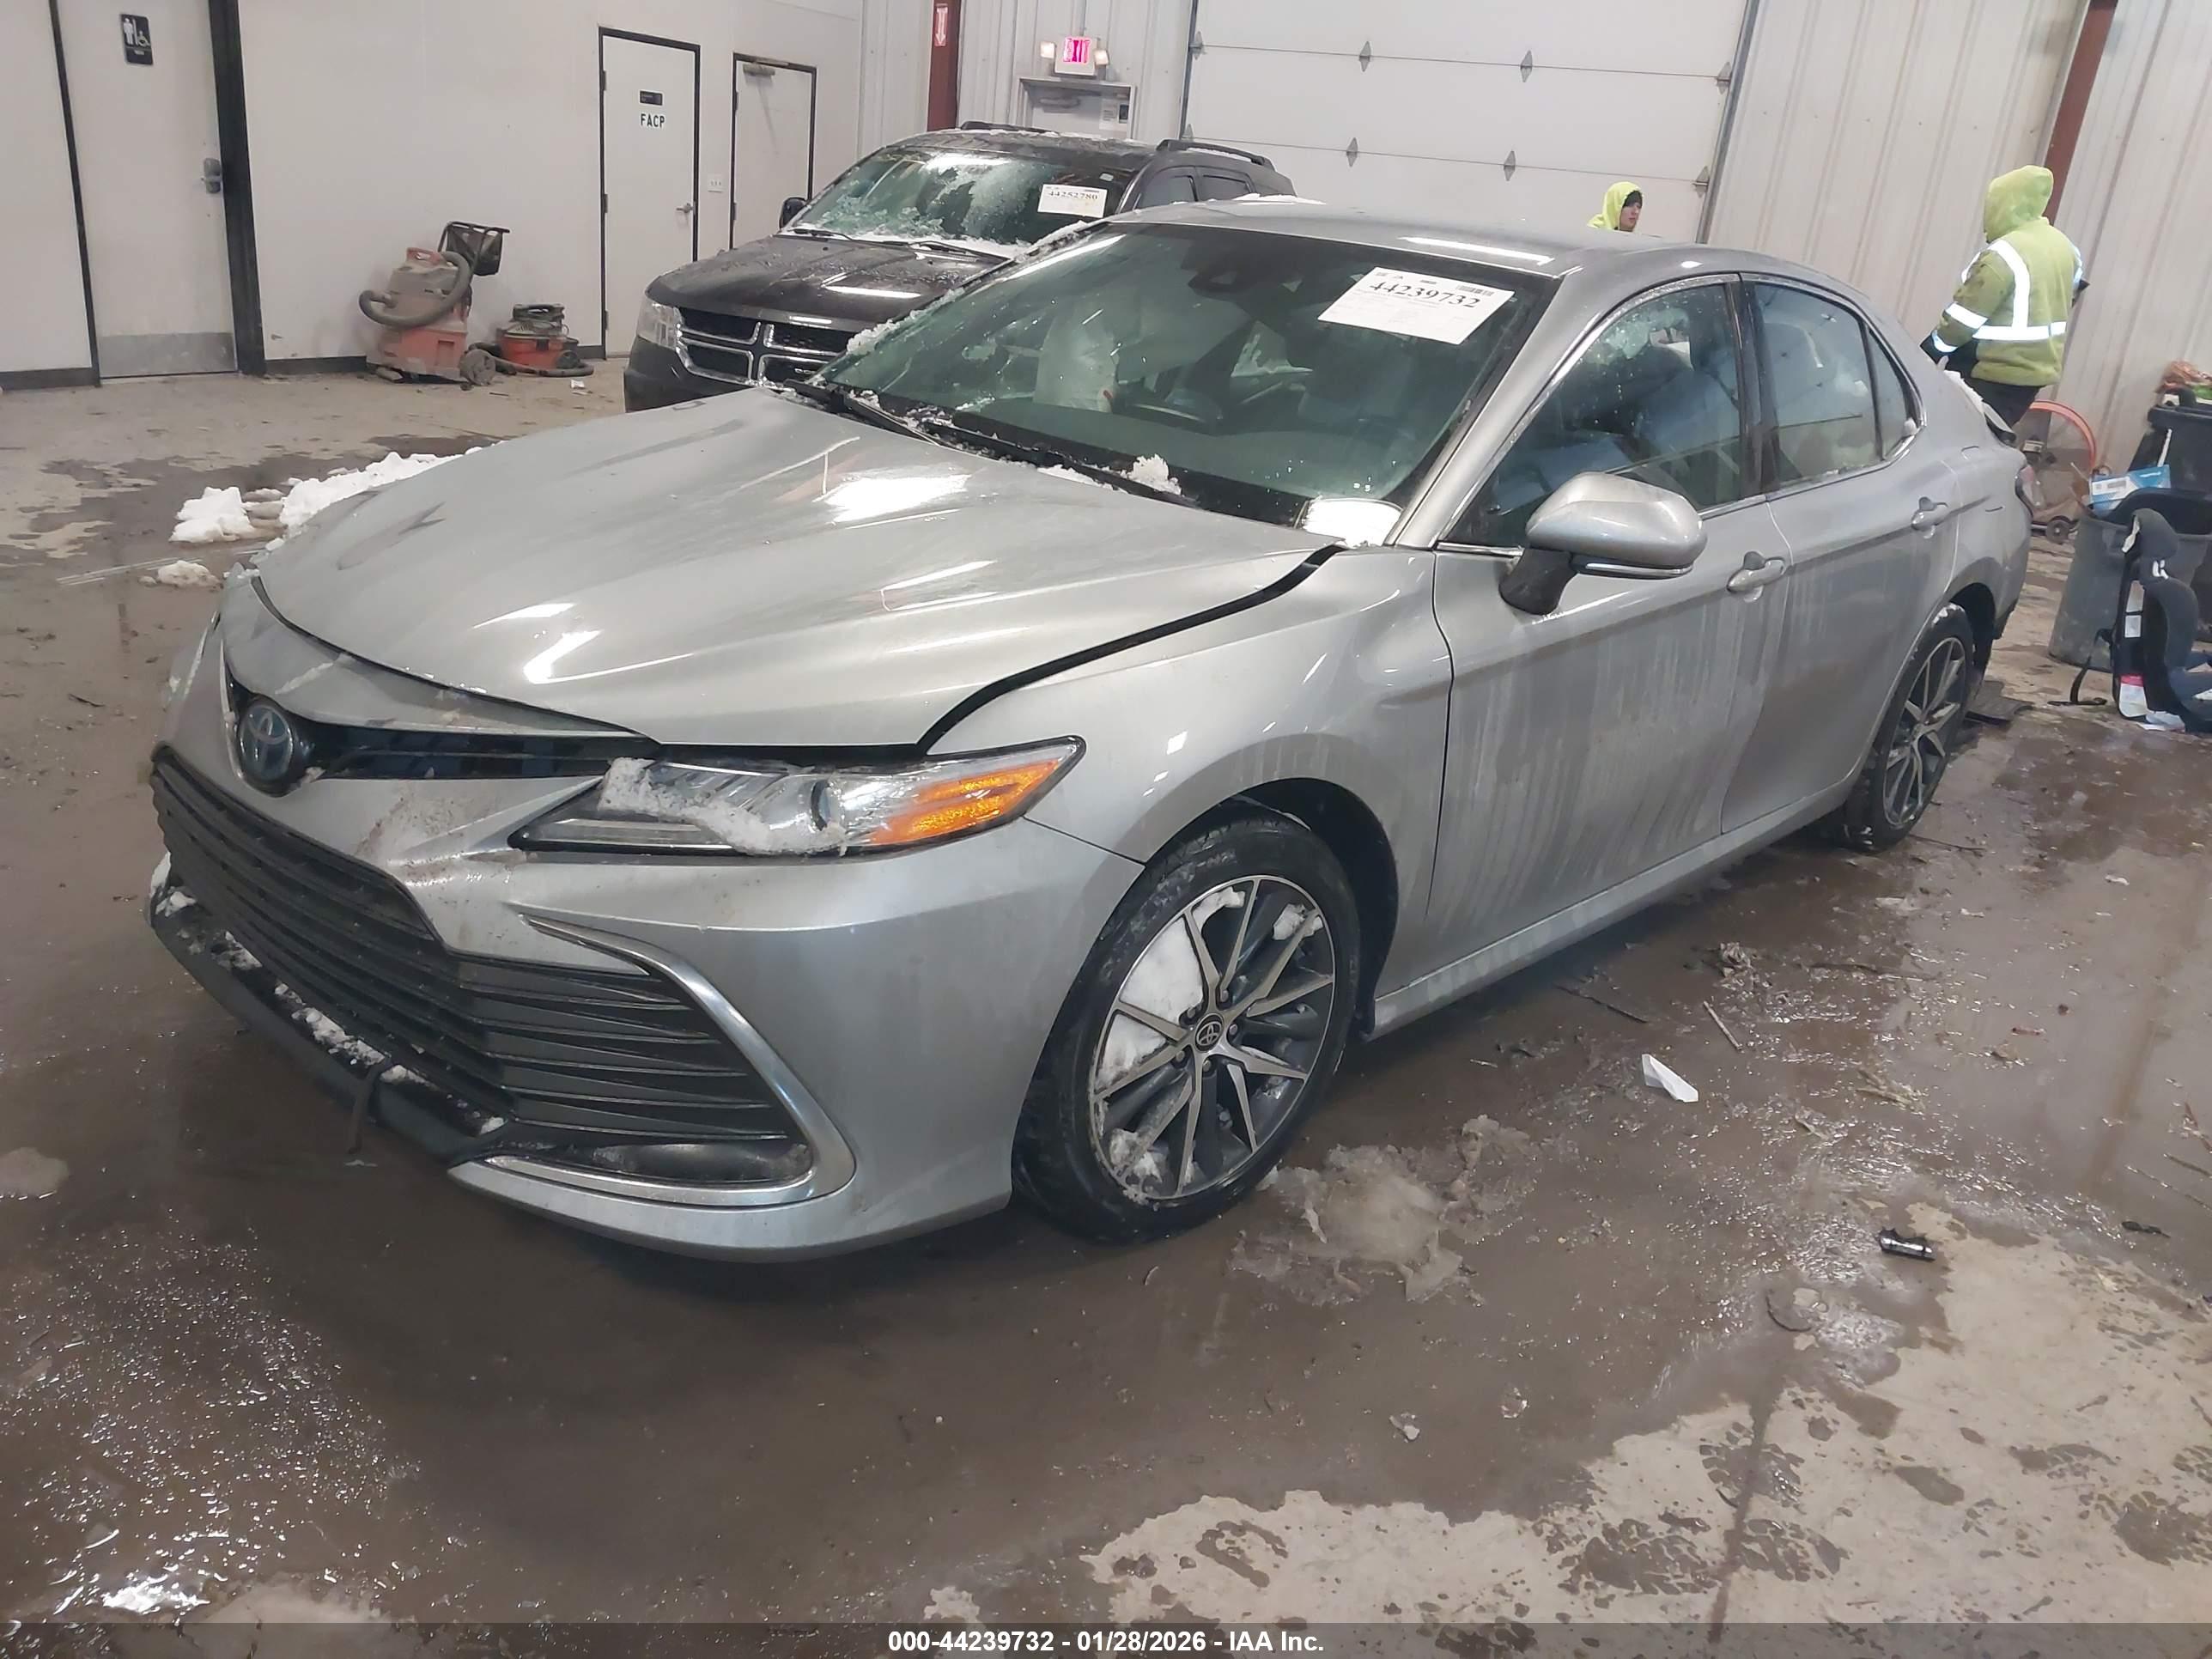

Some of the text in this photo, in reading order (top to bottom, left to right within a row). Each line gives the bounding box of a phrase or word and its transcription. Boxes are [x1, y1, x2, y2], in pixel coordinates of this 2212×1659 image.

[1063, 38, 1091, 63] EXIT
[641, 113, 665, 128] FACP
[1048, 191, 1098, 200] 44252780
[1367, 281, 1481, 308] 44239732
